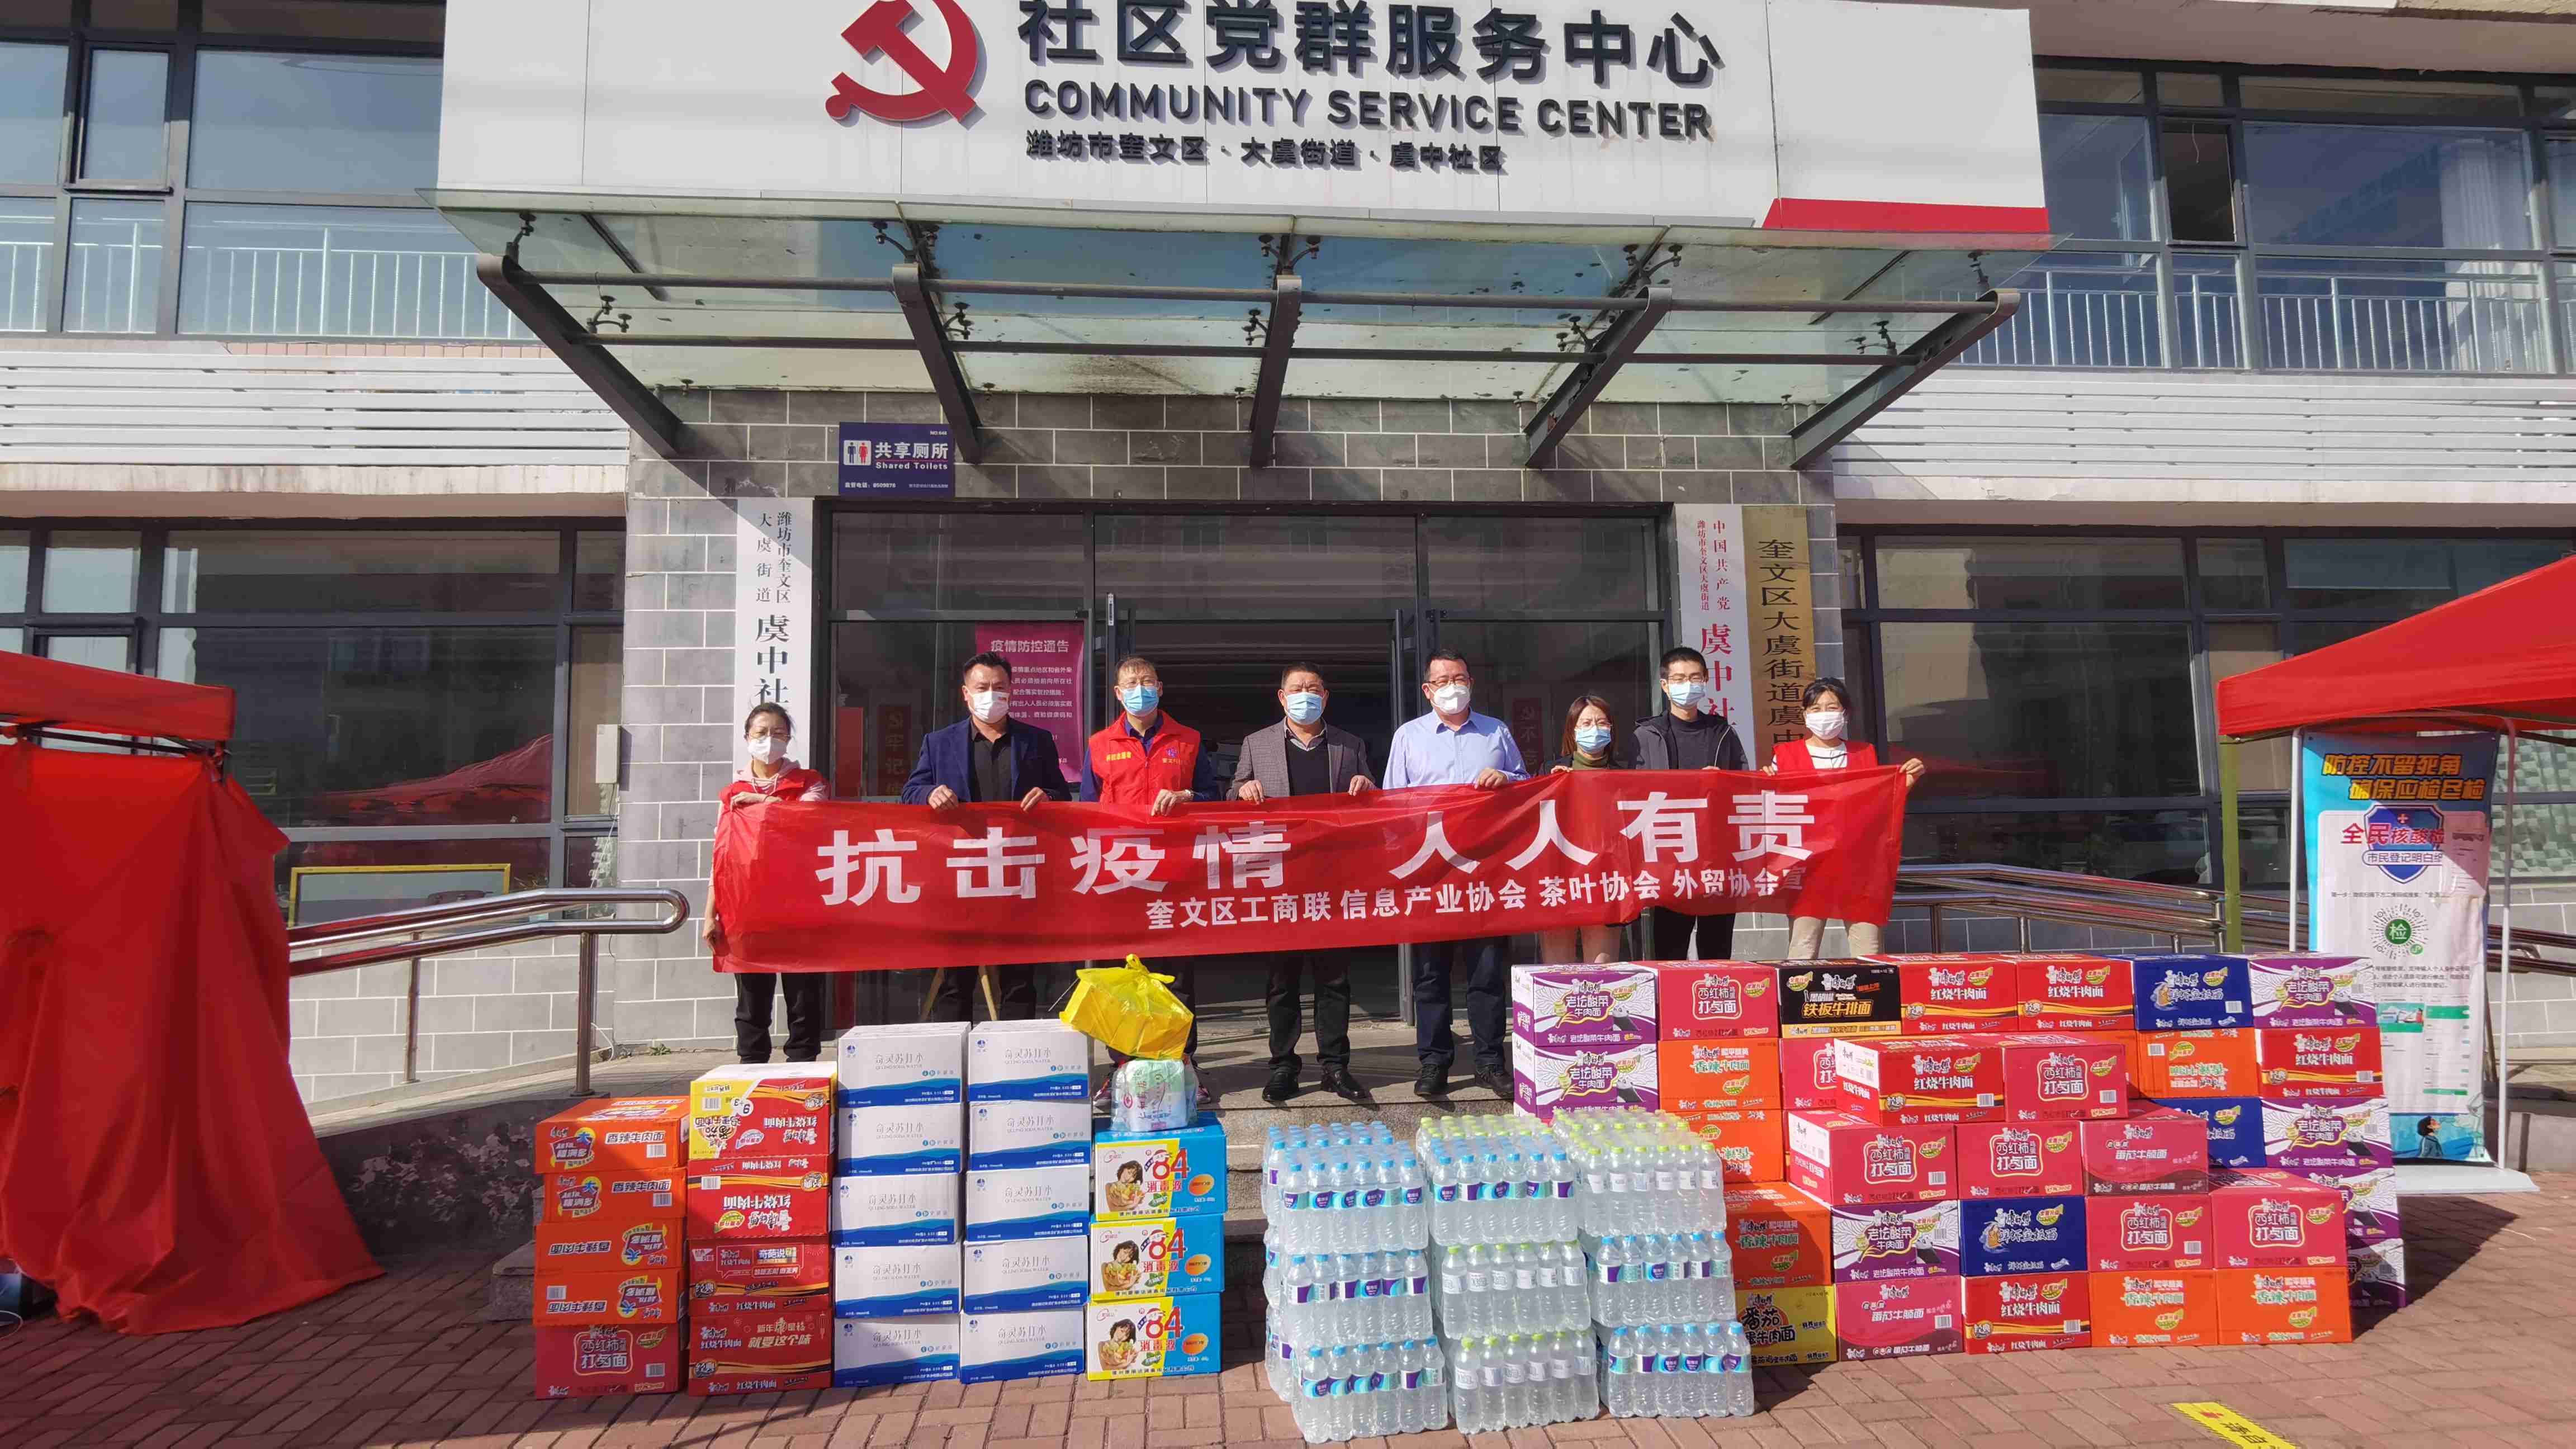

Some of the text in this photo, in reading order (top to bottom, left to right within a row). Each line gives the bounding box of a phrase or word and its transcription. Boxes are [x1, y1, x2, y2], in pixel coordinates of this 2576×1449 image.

[1018, 0, 1720, 84] 社区党群服务中心
[1025, 80, 1711, 138] COMMUNITY SERVICE CENTER
[875, 442, 948, 459] 共享厕所
[756, 513, 773, 603] 大虞街道
[776, 512, 792, 604] 潍坊市奎文区
[1697, 520, 1710, 611] 潍坊市奎文区大虞街道
[1713, 520, 1731, 611] 中国共产党
[991, 640, 1069, 653] 疫情防控通告
[2322, 754, 2464, 776] 防控不留死角
[2348, 778, 2486, 800] 确保应检尽检
[816, 790, 1815, 906] 抗击疫情 人人有责
[1145, 892, 1332, 930] 奎文区工商联
[1340, 876, 1527, 921] 信息产业协会
[1538, 869, 1661, 907] 茶叶协会
[2387, 922, 2409, 940] 检
[1698, 987, 1728, 1000] 西红柿
[1930, 988, 1987, 1000] 红烧牛肉面
[2048, 986, 2104, 998] 红烧牛肉面
[1566, 996, 1609, 1008] 老坛酸菜
[1698, 1000, 1736, 1014] 打卤面
[1803, 1002, 1873, 1016] 铁板牛排面
[1575, 1008, 1602, 1016] 牛肉面
[1569, 1068, 1613, 1079] 老坛酸菜
[2044, 1067, 2076, 1079] 西红柿
[1578, 1080, 1606, 1088] 牛肉面
[1914, 1076, 1973, 1090] 红烧牛肉面
[2044, 1081, 2083, 1094] 打卤面
[764, 1117, 817, 1128] 红烧牛肉面
[576, 1132, 593, 1145] 大
[607, 1132, 665, 1143] 香辣牛肉面
[1871, 1149, 1905, 1162] 西红柿
[1996, 1142, 2030, 1155] 西红柿
[1153, 1148, 1190, 1180] 84
[1871, 1162, 1911, 1177] 打卤面
[1996, 1156, 2037, 1170] 打卤面
[583, 1180, 600, 1195] 大
[612, 1180, 671, 1192] 香辣牛肉面
[1147, 1180, 1182, 1194] 消毒液
[723, 1195, 791, 1209] 红烧牛肉面
[2127, 1217, 2160, 1230] 西红柿
[2255, 1213, 2289, 1225] 西红柿
[1868, 1227, 1912, 1239] 老坛酸菜
[2127, 1230, 2167, 1245] 打卤面
[2255, 1227, 2298, 1240] 打卤面
[551, 1242, 610, 1254] 香辣牛肉面
[1149, 1228, 1186, 1260] 84
[1877, 1240, 1905, 1249] 牛肉面
[627, 1248, 641, 1262] 大
[1143, 1261, 1180, 1273] 消毒液
[547, 1301, 606, 1313] 香辣牛肉面
[622, 1300, 636, 1314] 大
[2001, 1301, 2061, 1317] 红烧牛肉面
[1145, 1307, 1183, 1339] 84
[1742, 1307, 1780, 1330] 番茄
[1746, 1326, 1795, 1344] 蛋牛肉面
[1140, 1339, 1177, 1352] 消毒液
[581, 1353, 627, 1369] 打卤面
